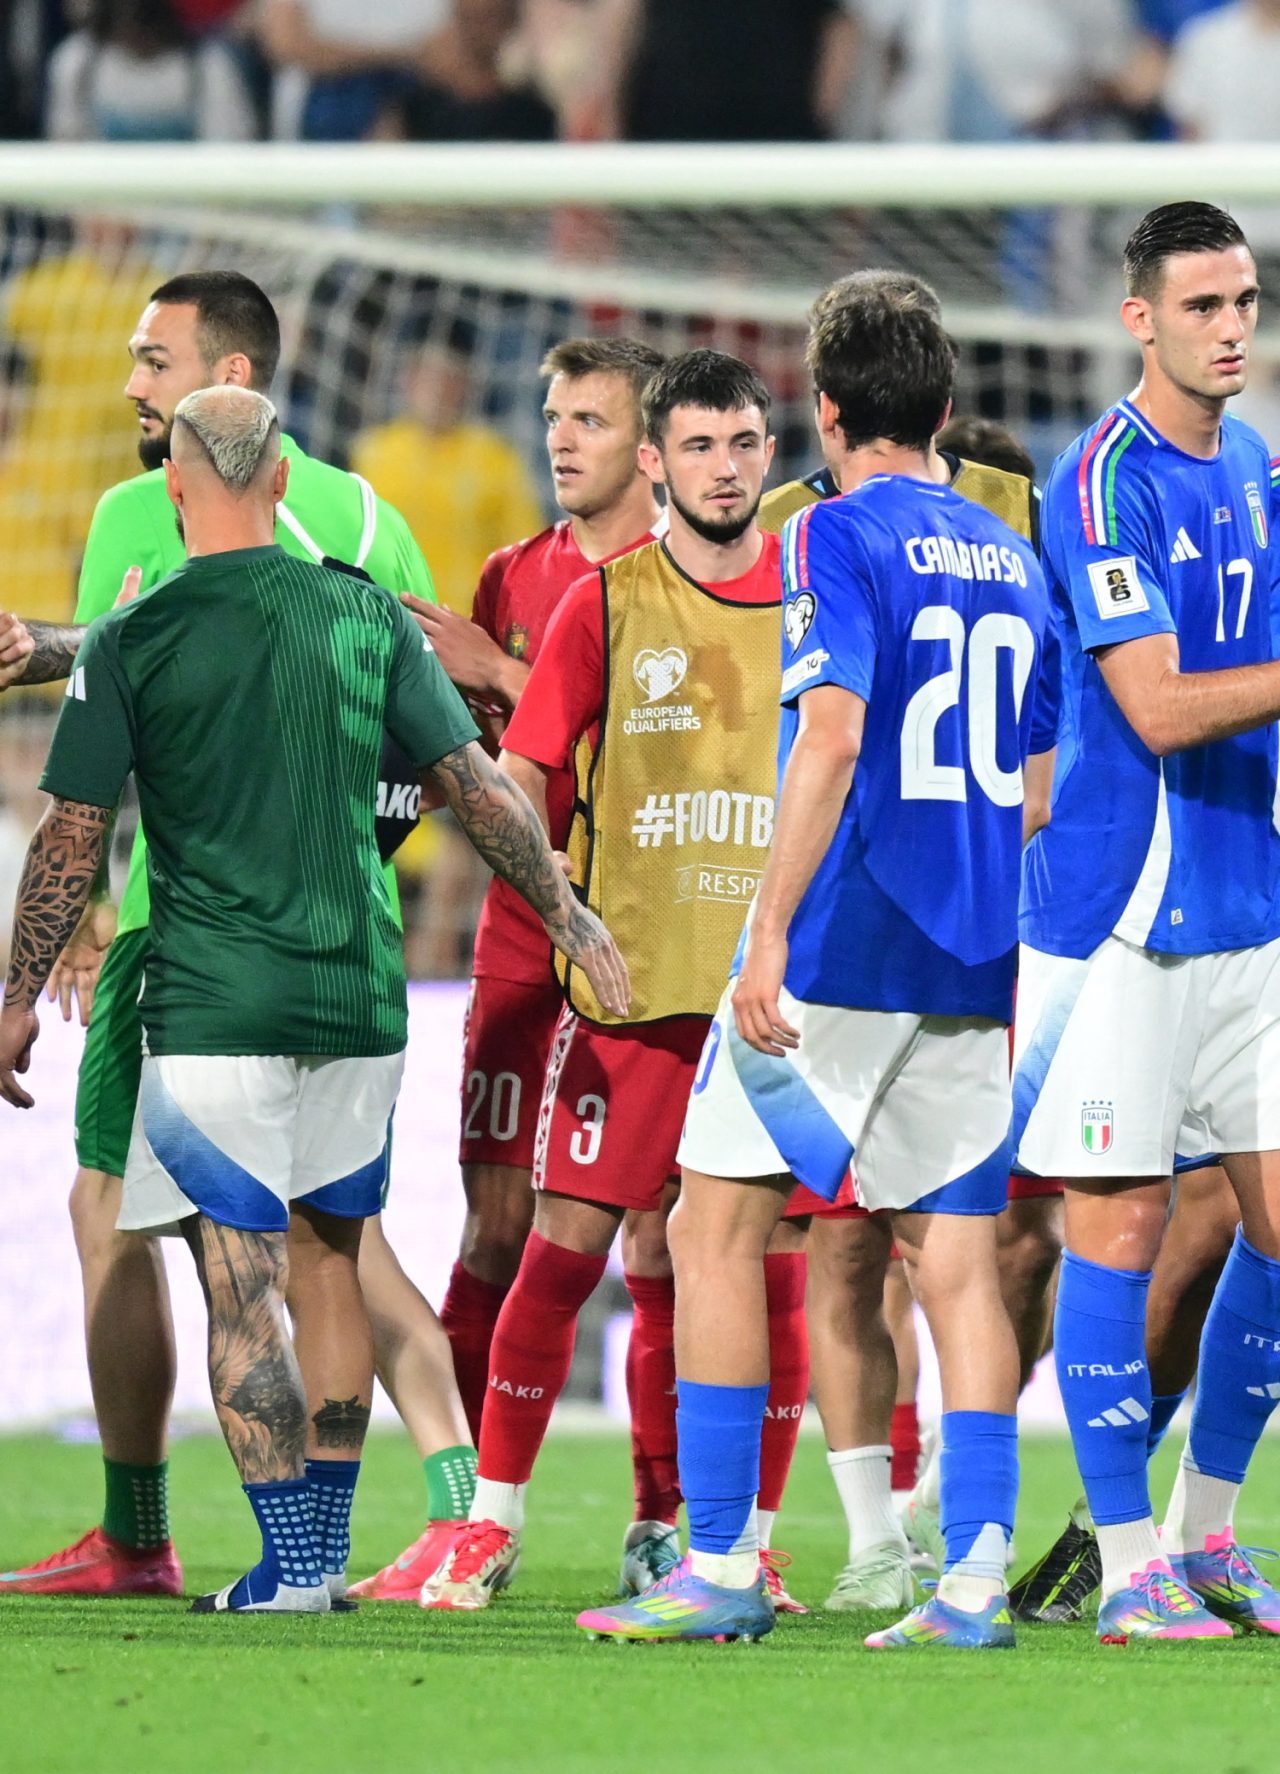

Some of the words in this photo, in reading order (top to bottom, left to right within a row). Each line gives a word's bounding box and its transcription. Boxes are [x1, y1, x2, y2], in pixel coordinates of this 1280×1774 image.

[905, 536, 1028, 588] CAMBIASO
[1215, 558, 1253, 643] 17
[630, 705, 693, 719] EUROPEAN
[901, 605, 1035, 808] 20
[623, 716, 701, 735] QUALIFIERS
[376, 781, 422, 820] AKO
[631, 789, 775, 848] #FOOTB
[698, 871, 763, 896] RESP
[464, 1070, 522, 1141] 20
[1083, 1112, 1110, 1121] ITALIA
[569, 1093, 607, 1165] 3
[1067, 1359, 1146, 1378] ITALIA
[489, 1375, 544, 1400] JAKO
[763, 1403, 801, 1420] AKO
